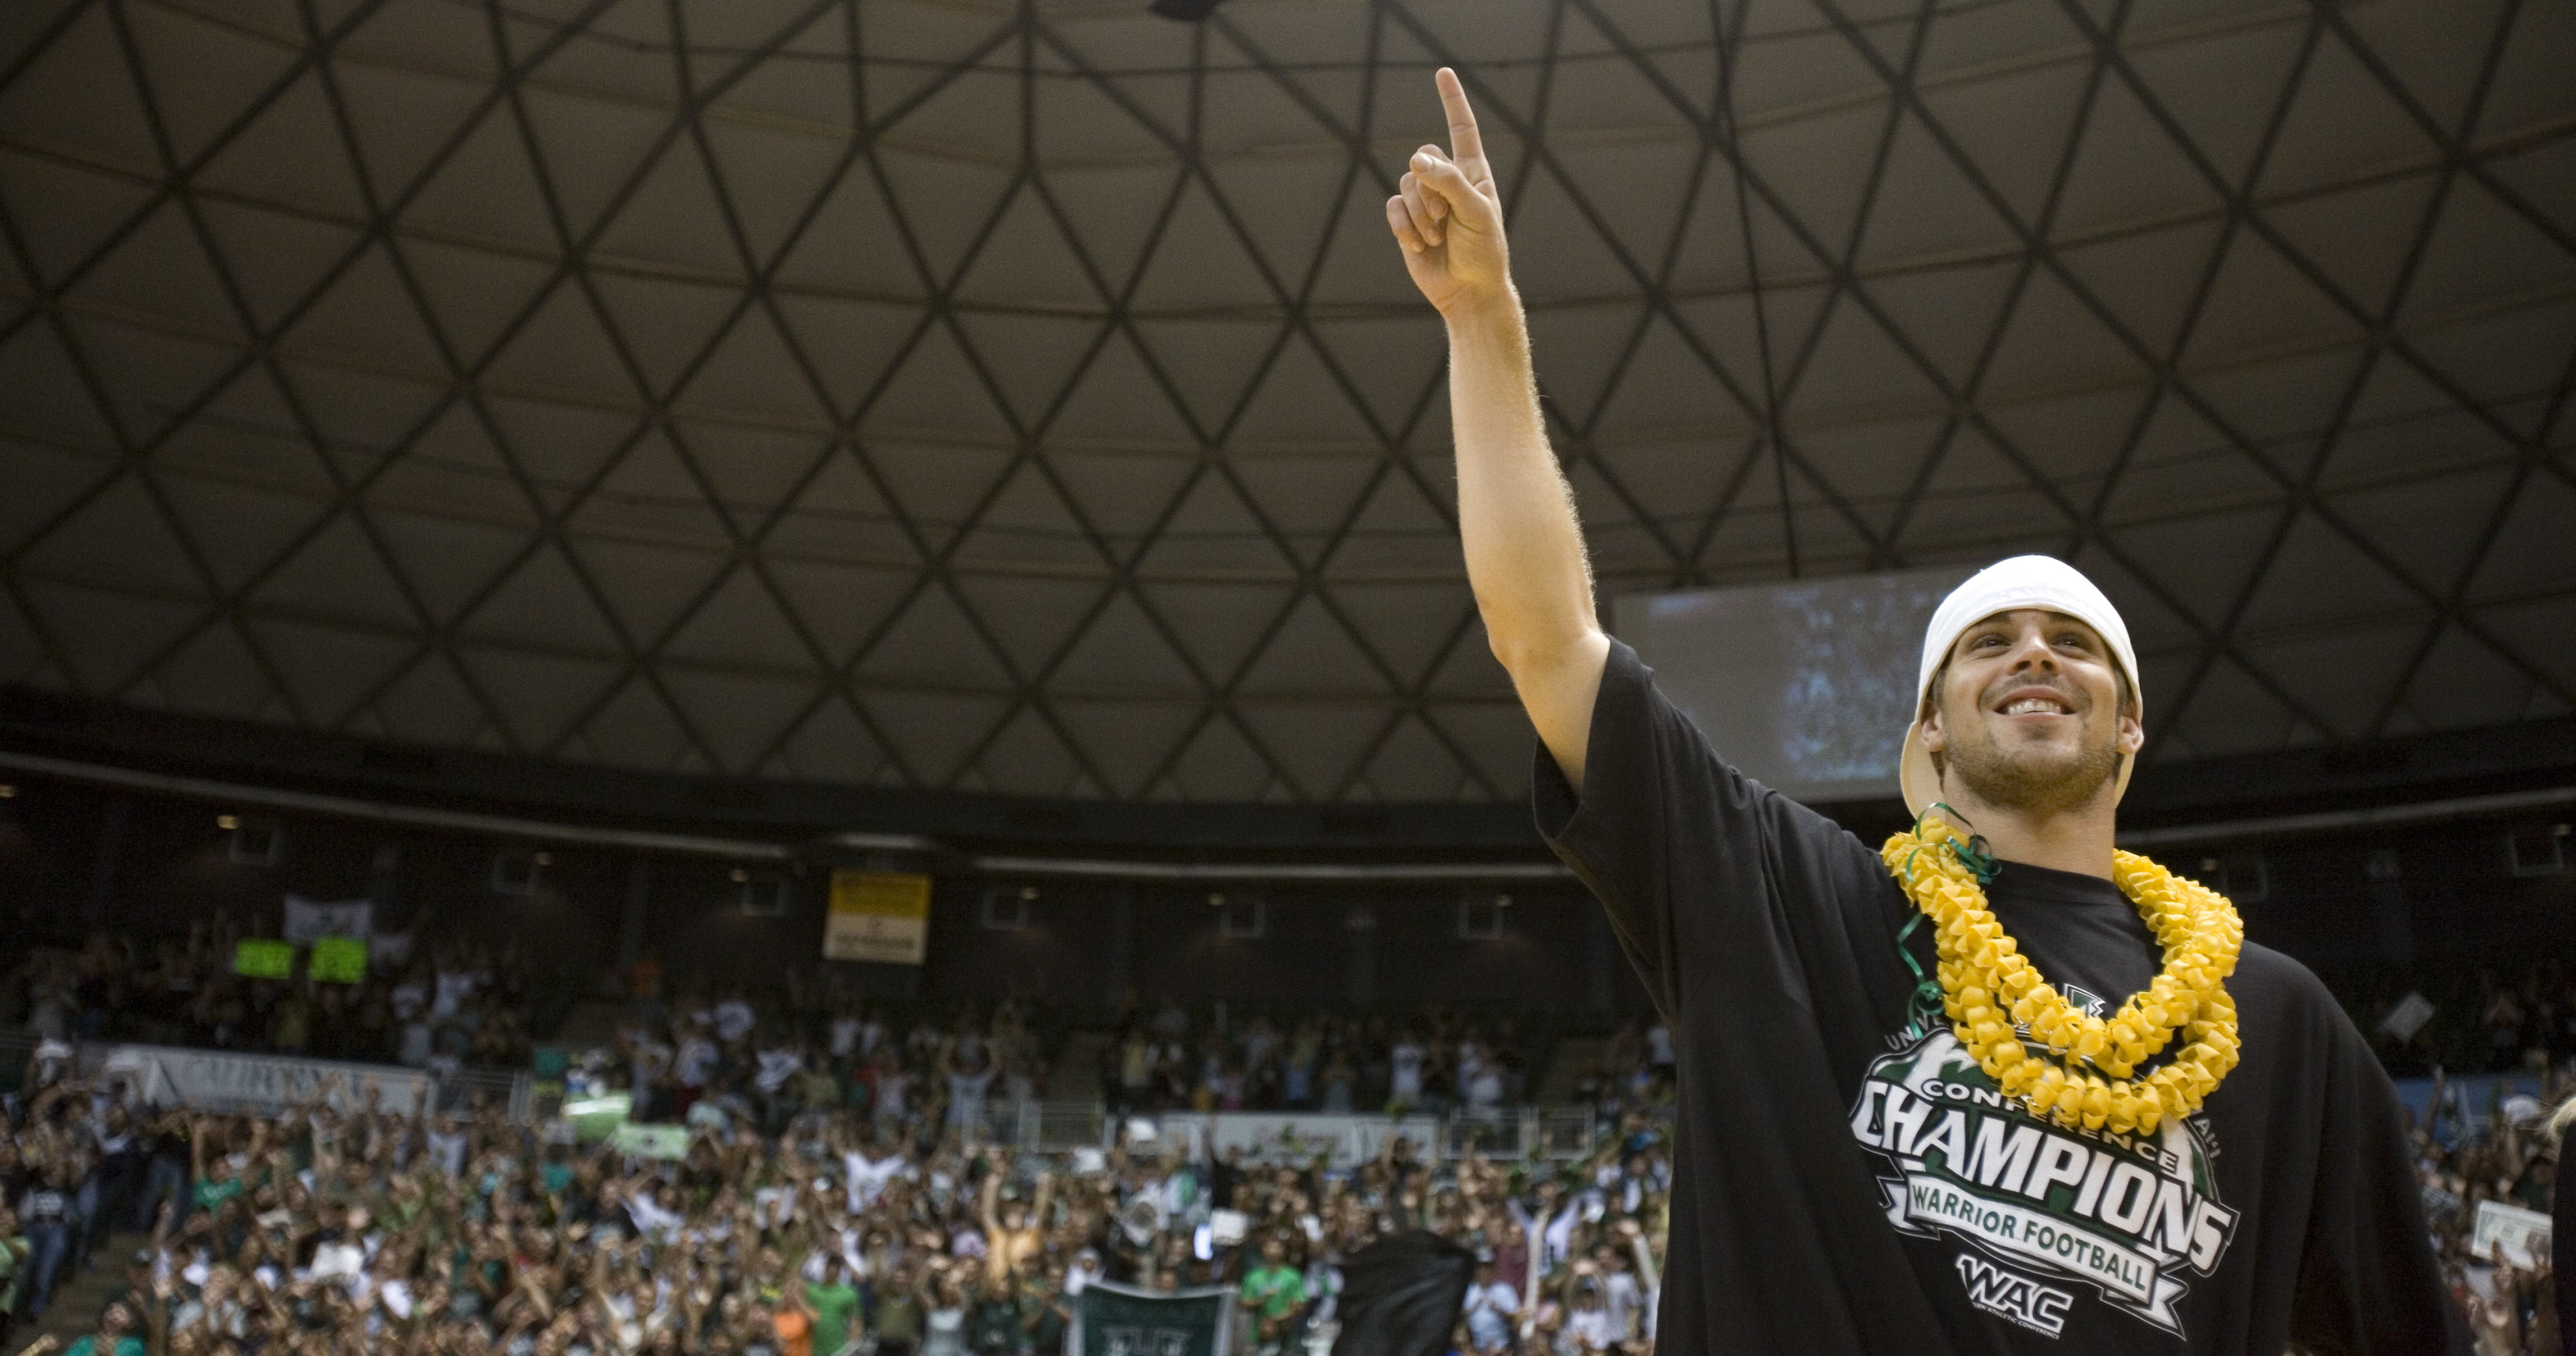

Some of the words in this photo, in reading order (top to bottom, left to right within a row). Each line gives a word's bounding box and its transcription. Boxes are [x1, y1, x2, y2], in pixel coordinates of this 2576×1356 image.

[1851, 1079, 2232, 1271] CHAMPIONS
[1912, 1184, 2017, 1239] WARRIOR
[2023, 1219, 2147, 1290] FOOTBALL
[1956, 1254, 2074, 1334] WAC
[1986, 1307, 2018, 1324] ATHLETIC
[2017, 1320, 2059, 1340] CONFERENCE
